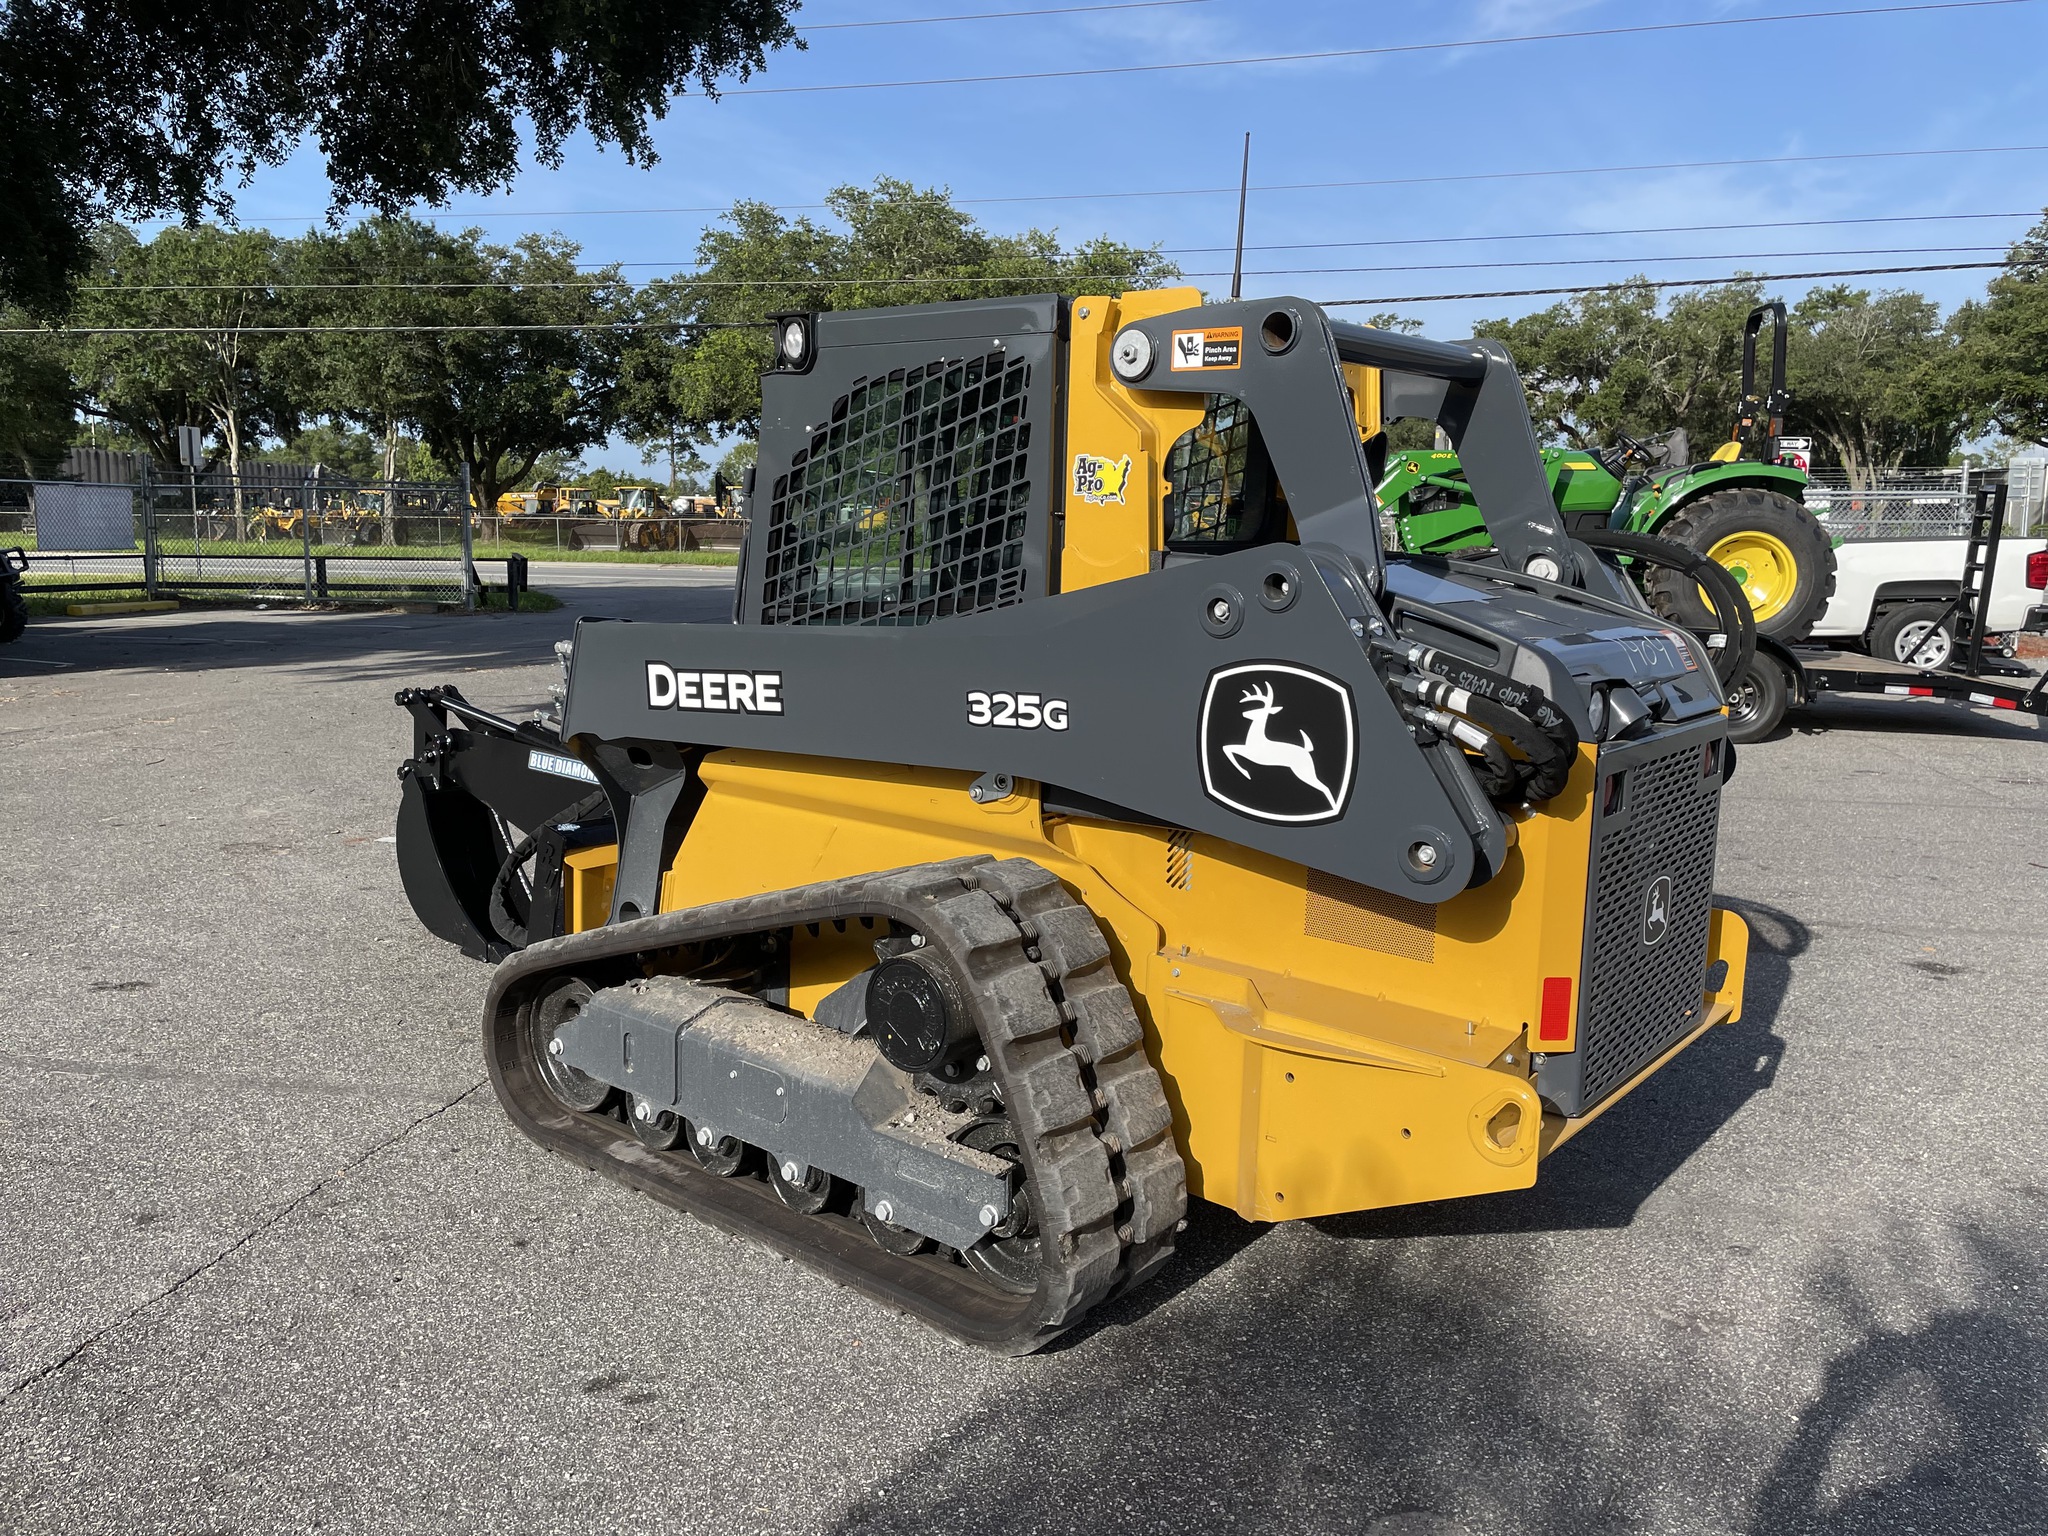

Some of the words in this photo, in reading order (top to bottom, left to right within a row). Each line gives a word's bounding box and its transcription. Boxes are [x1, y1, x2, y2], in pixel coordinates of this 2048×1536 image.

[1077, 457, 1102, 478] Ag-
[1077, 475, 1103, 492] Pro
[647, 663, 782, 712] DEERE
[1458, 671, 1495, 697] FC425
[967, 691, 1069, 731] 325G
[530, 753, 555, 771] BLUE
[554, 758, 599, 782] DIAMON
